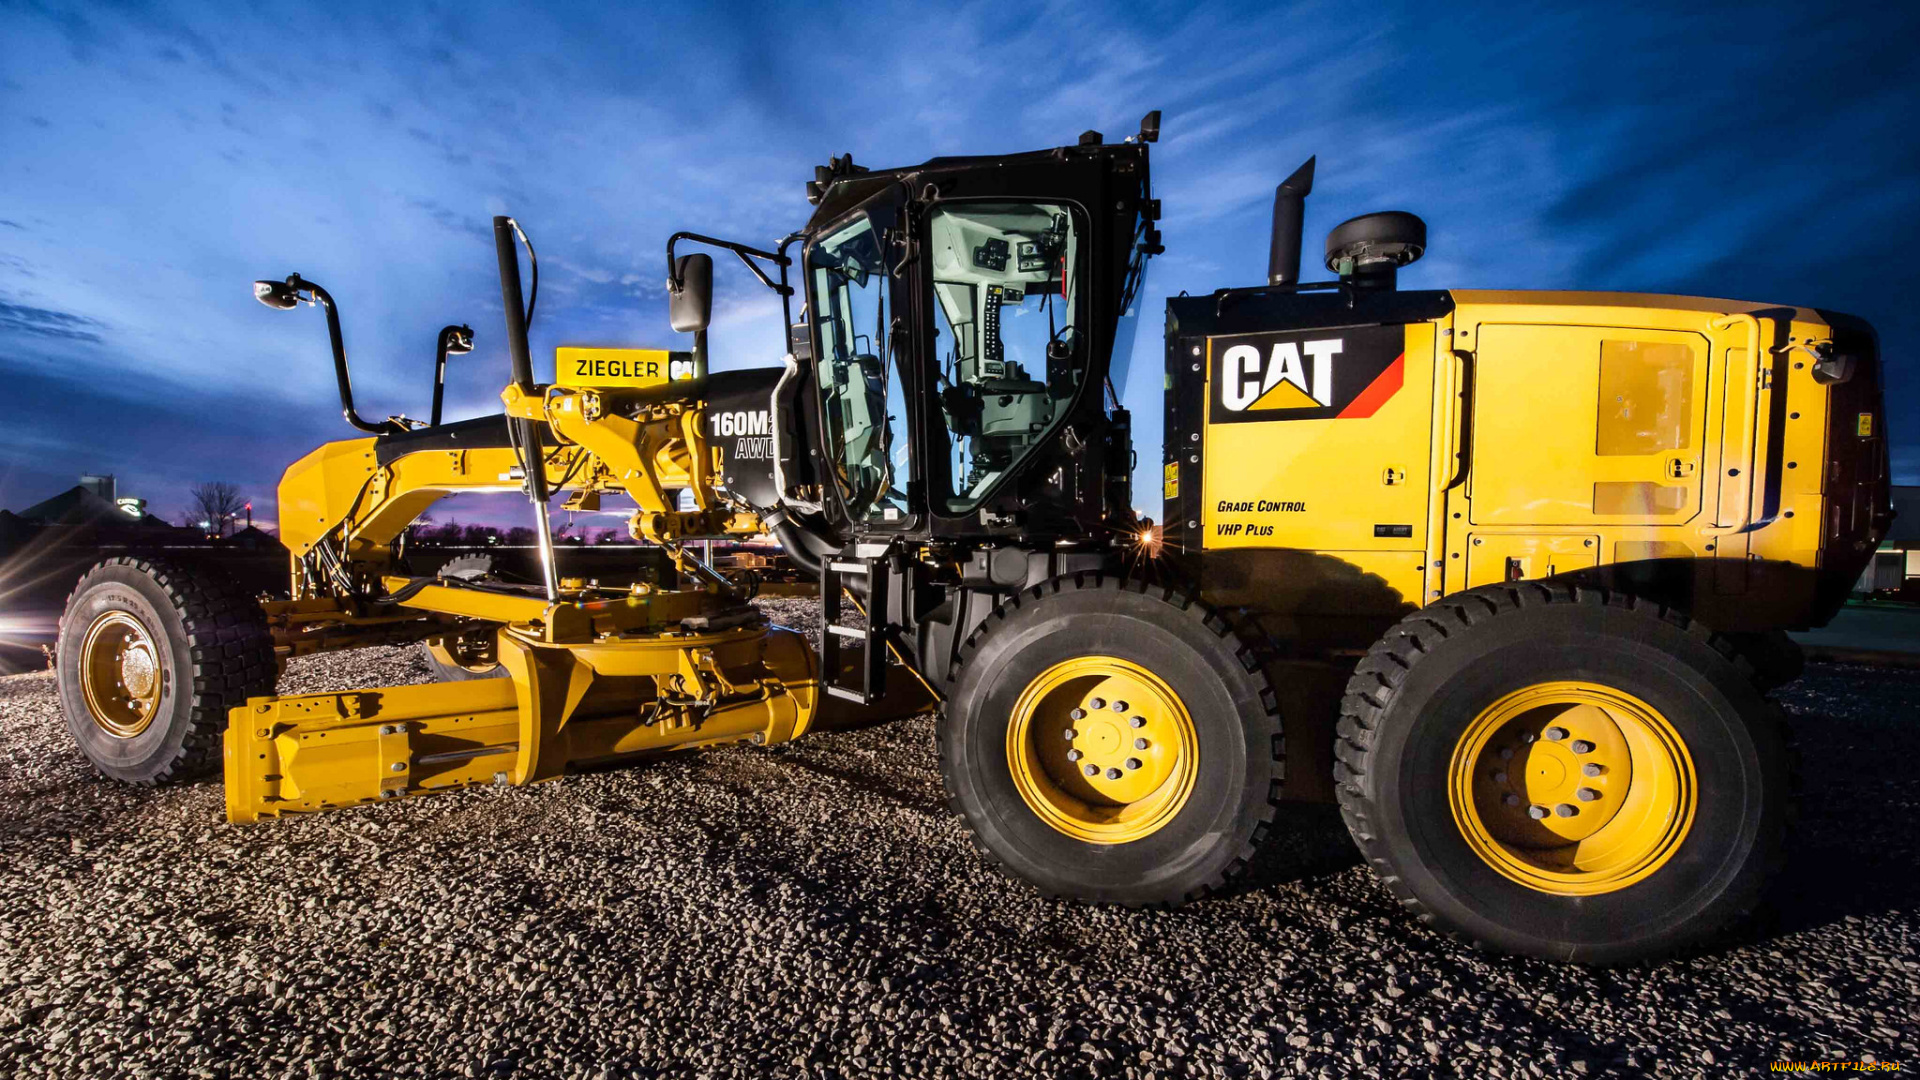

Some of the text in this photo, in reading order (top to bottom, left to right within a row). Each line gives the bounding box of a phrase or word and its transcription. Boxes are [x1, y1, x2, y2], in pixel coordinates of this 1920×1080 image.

[576, 359, 659, 378] ZIEGLER
[1222, 338, 1343, 411] CAT
[1217, 523, 1242, 536] VHP
